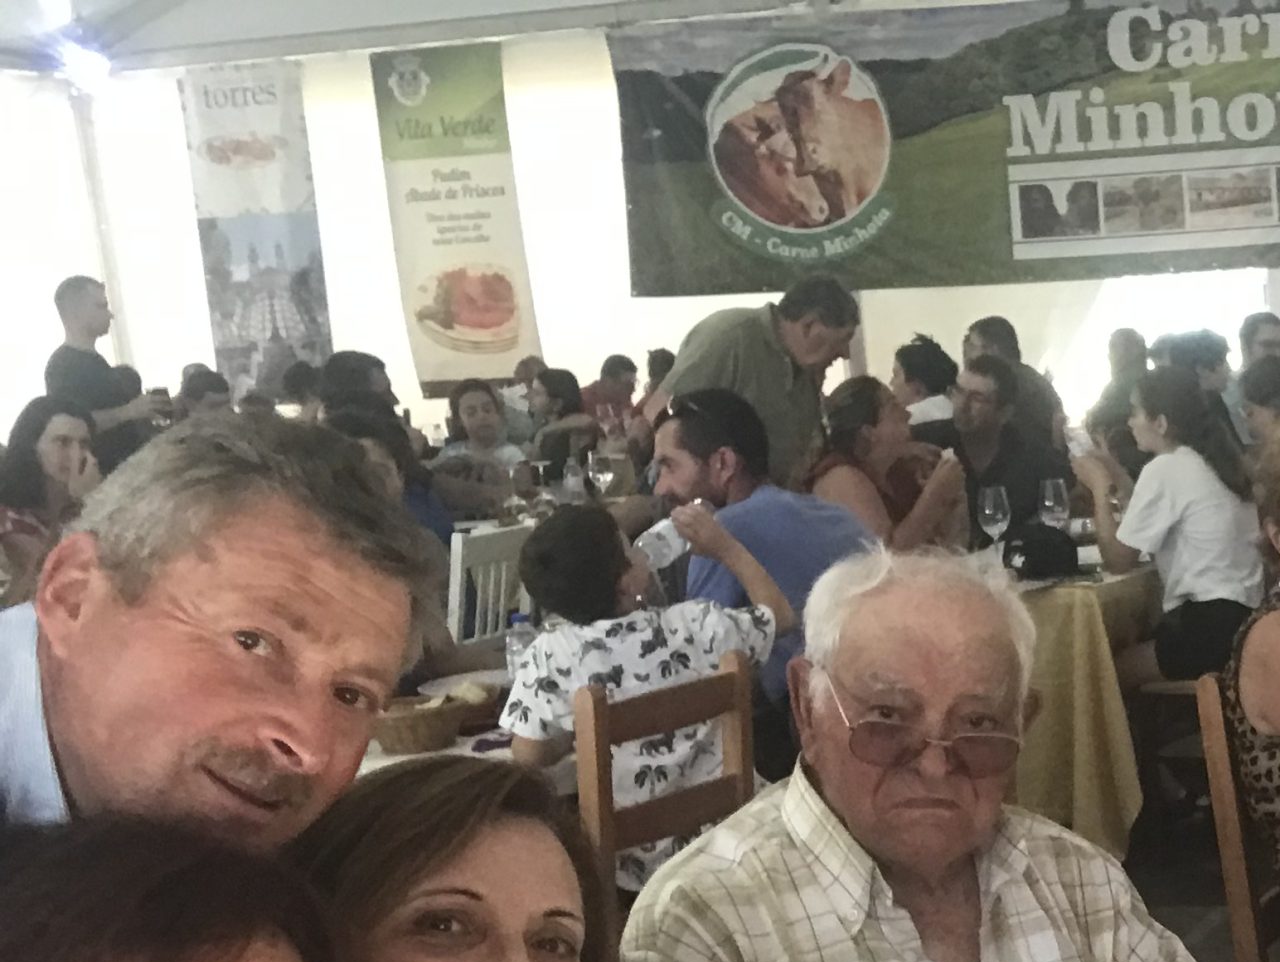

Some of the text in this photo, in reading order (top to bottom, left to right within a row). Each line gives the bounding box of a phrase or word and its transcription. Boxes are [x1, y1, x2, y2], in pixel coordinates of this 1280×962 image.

[203, 83, 278, 109] torres
[439, 114, 496, 138] Verde
[721, 210, 752, 240] CM
[766, 237, 819, 259] Carne
[823, 207, 891, 257] Minhota
